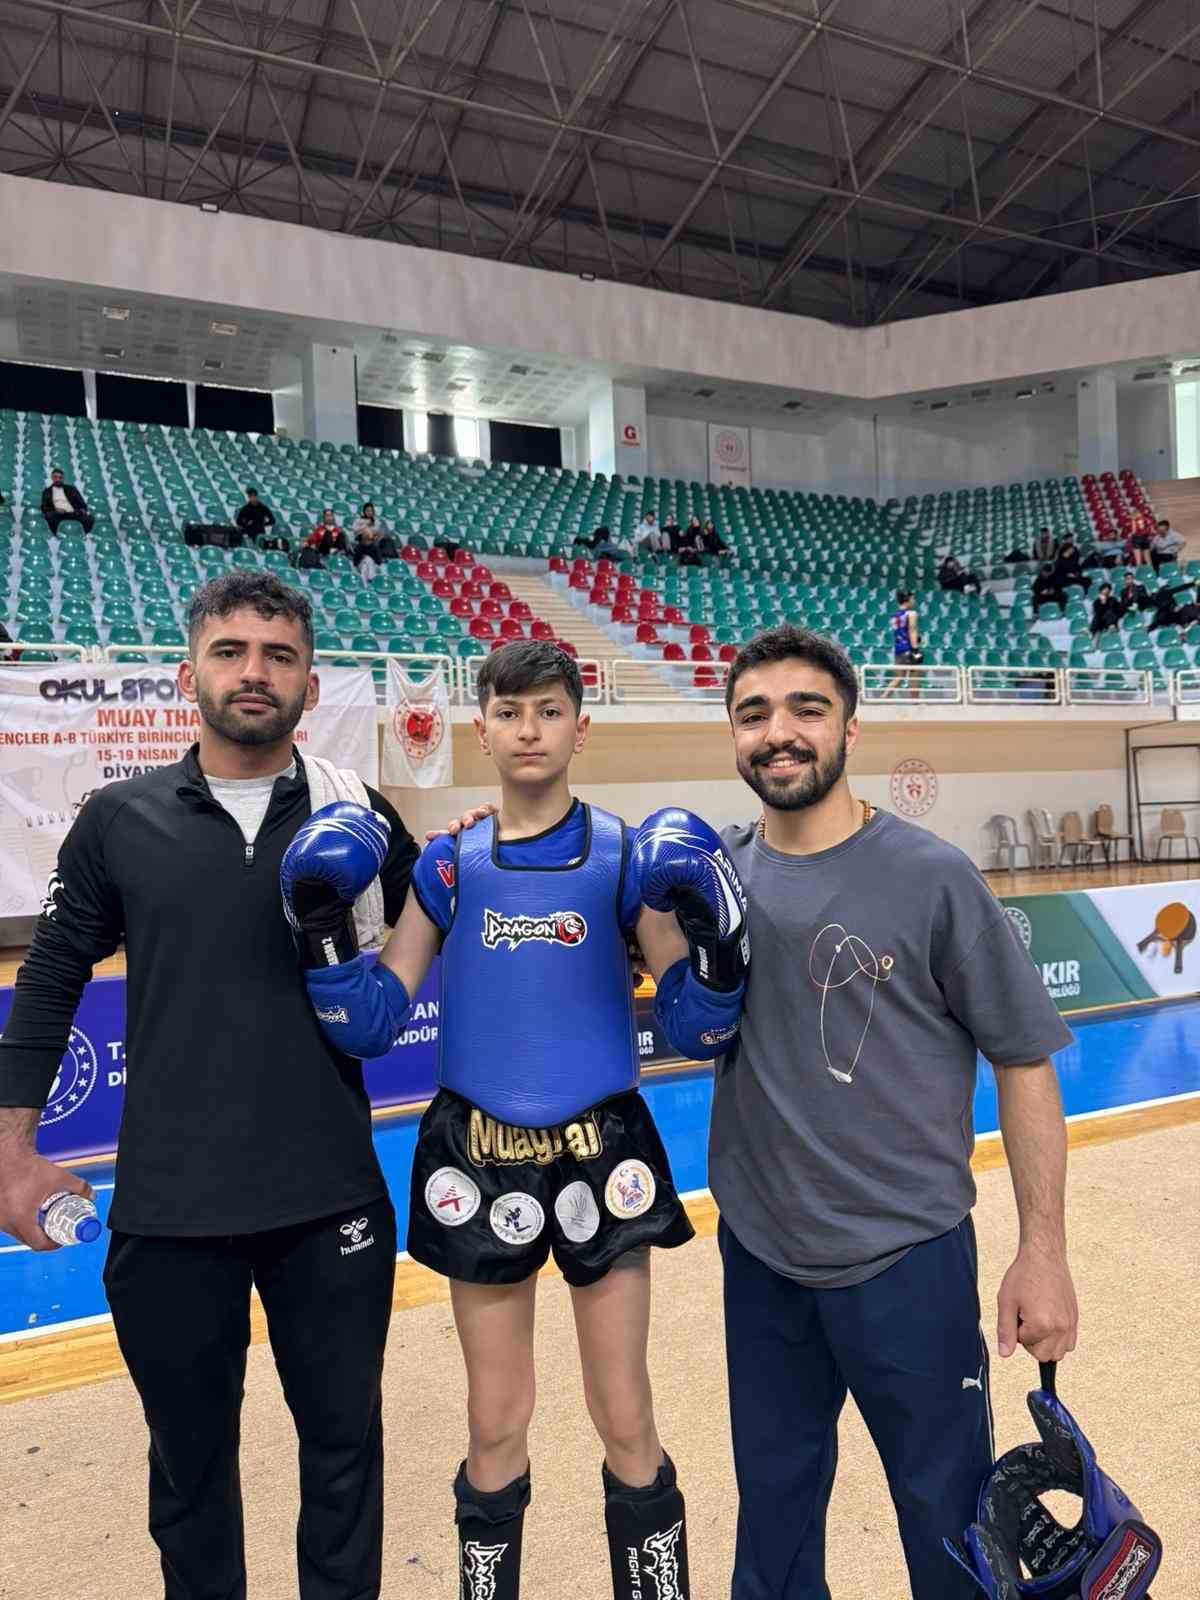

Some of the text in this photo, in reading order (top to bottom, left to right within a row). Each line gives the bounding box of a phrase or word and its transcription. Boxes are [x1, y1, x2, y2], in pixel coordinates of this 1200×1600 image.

[624, 425, 637, 440] G
[40, 679, 118, 702] OKUL
[97, 709, 156, 727] MUAY
[54, 732, 77, 745] A-B
[81, 731, 134, 744] TÜRKİYE
[97, 747, 178, 761] 15-19 NİSAN
[340, 1233, 375, 1256] hummel
[626, 1546, 641, 1587] FIGHT
